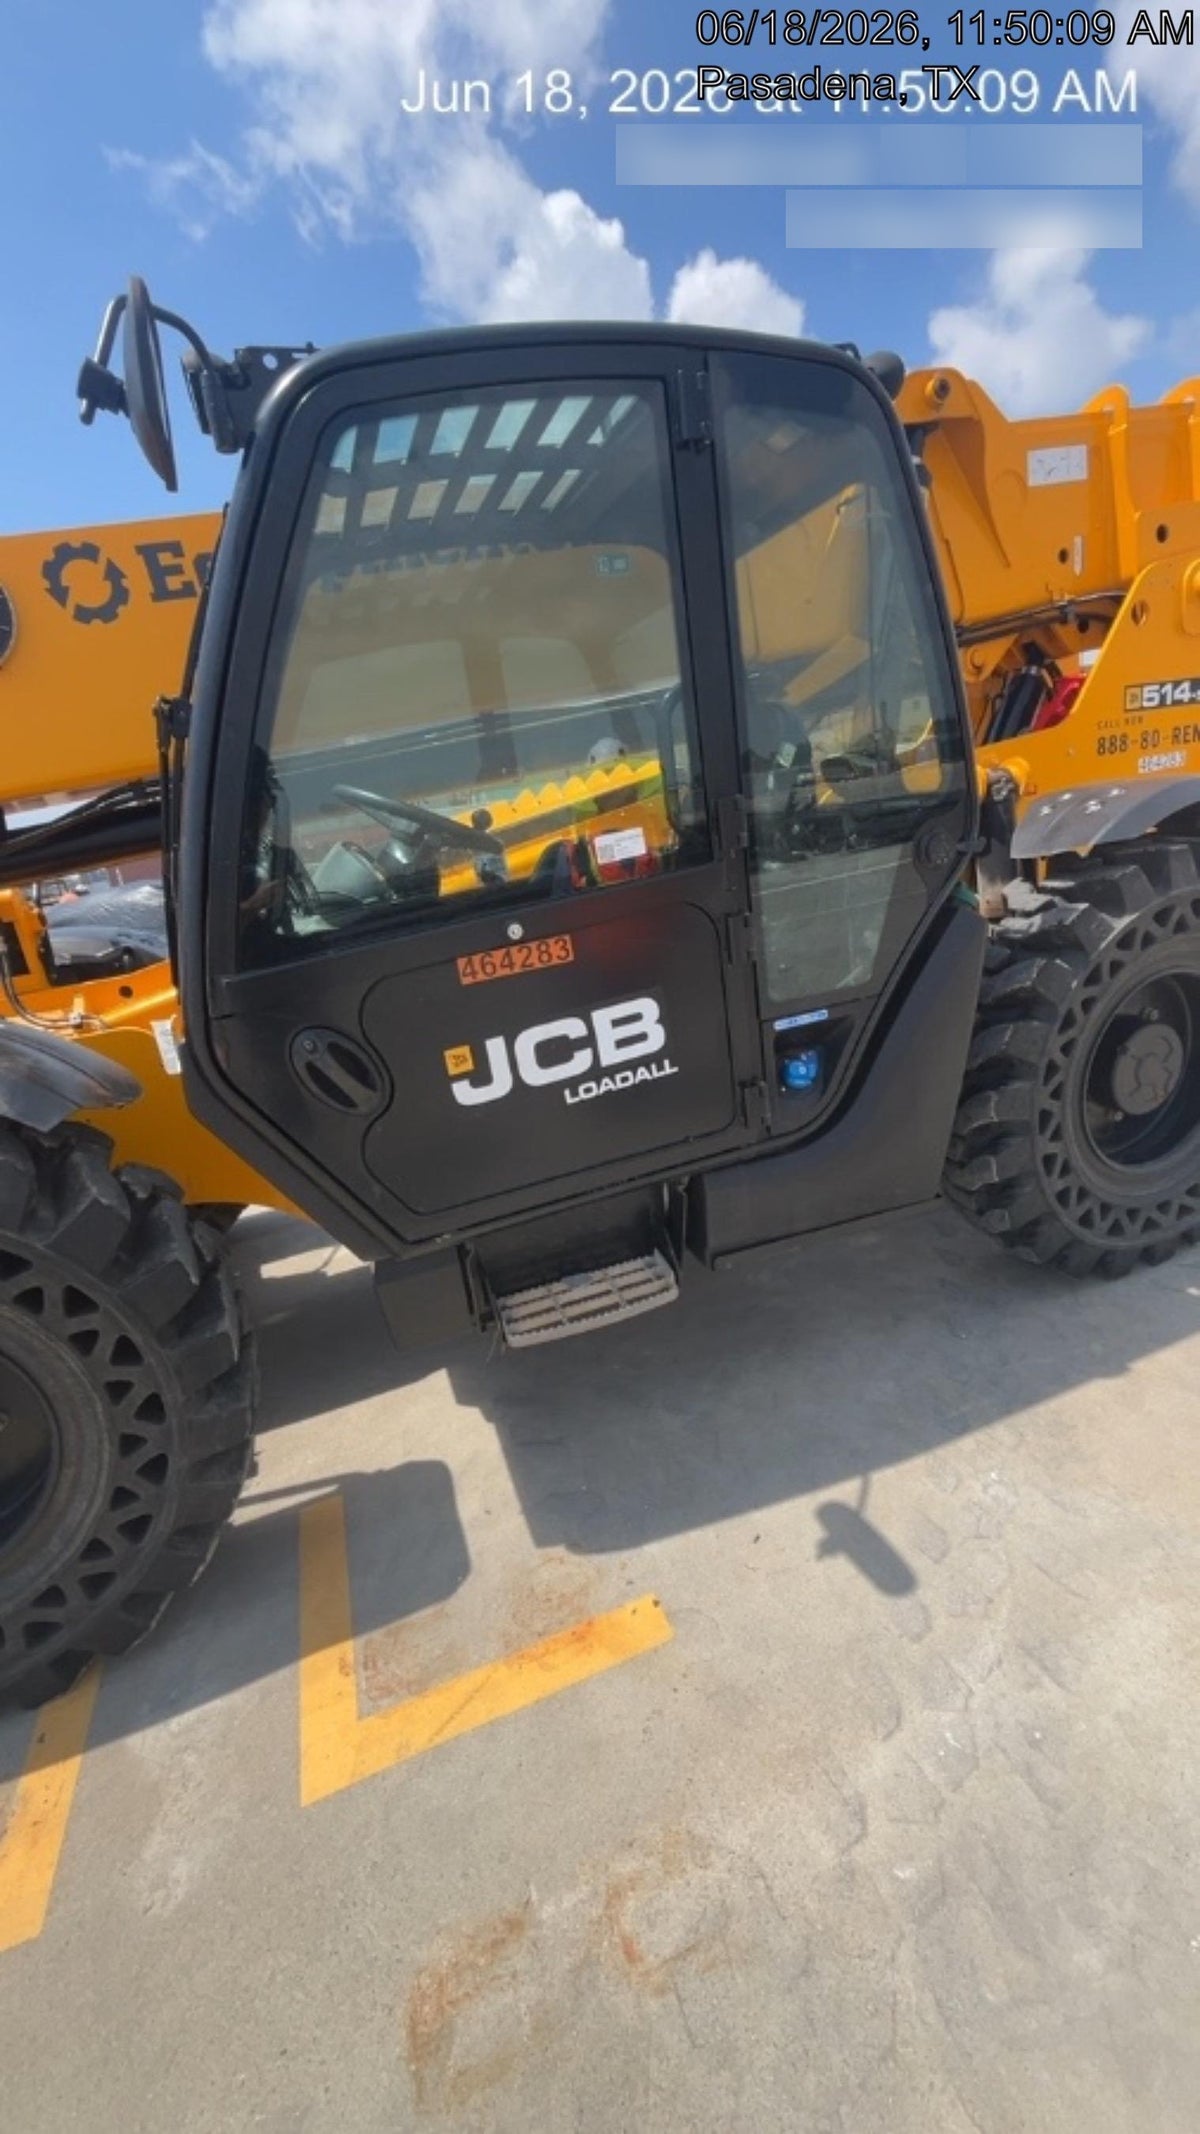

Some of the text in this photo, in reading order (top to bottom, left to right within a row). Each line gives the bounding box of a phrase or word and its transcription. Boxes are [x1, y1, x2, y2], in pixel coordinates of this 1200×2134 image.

[460, 938, 573, 980] 464283
[452, 997, 666, 1106] JCB
[564, 1059, 679, 1105] LOADALL
